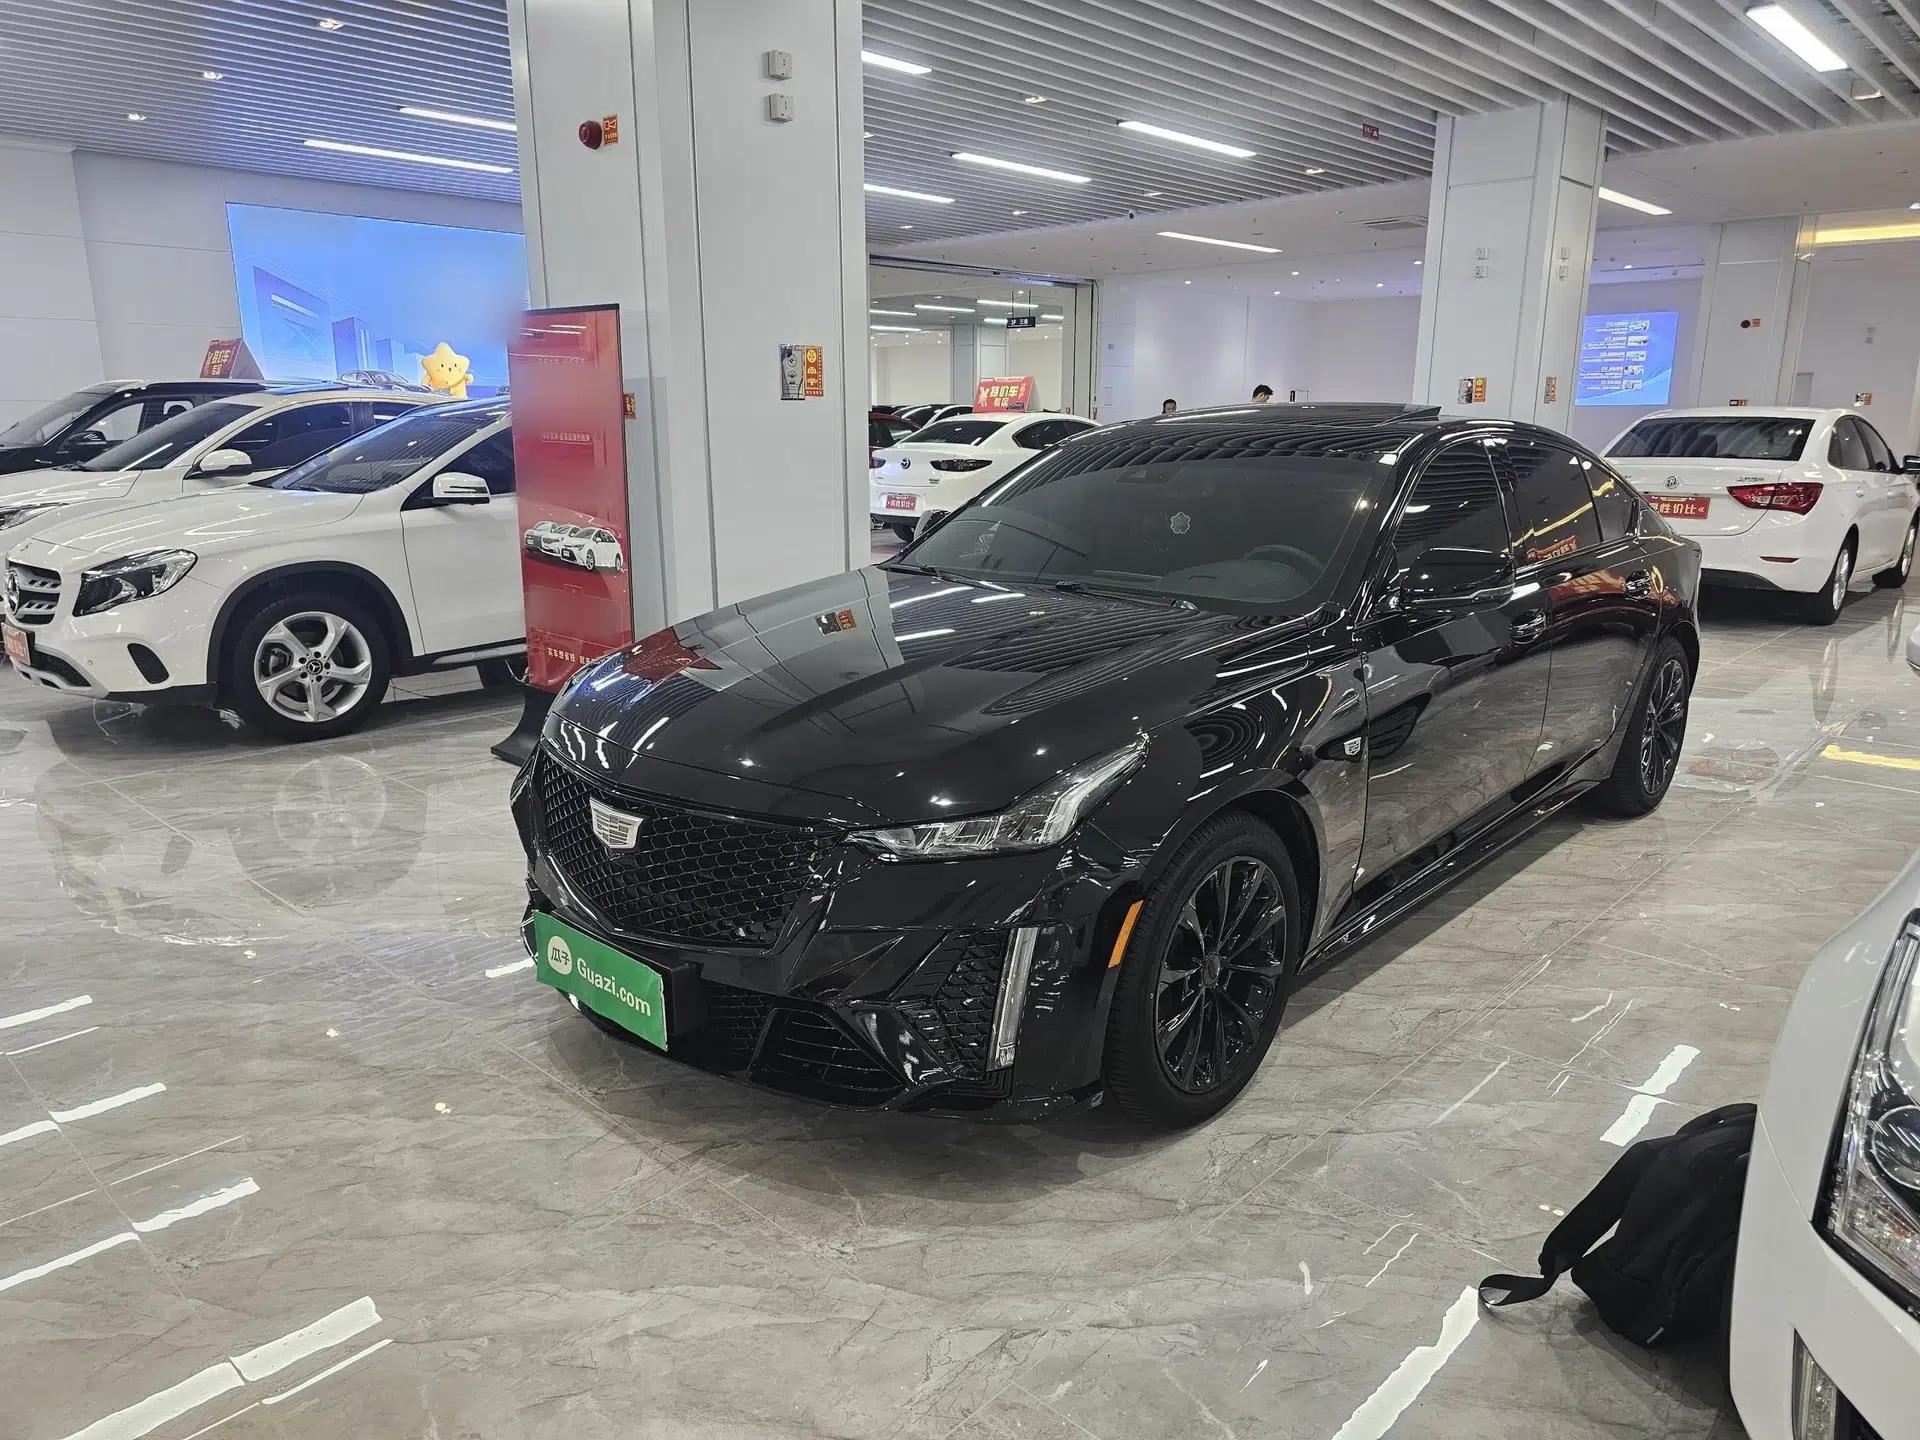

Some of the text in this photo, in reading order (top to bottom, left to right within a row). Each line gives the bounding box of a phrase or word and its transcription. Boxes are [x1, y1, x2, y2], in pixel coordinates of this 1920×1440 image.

[990, 385, 1019, 397] 特价车
[994, 397, 1009, 407] 专区
[547, 647, 576, 662] 买车想省钱
[551, 947, 651, 1017] 瓜子 Guazi.com
